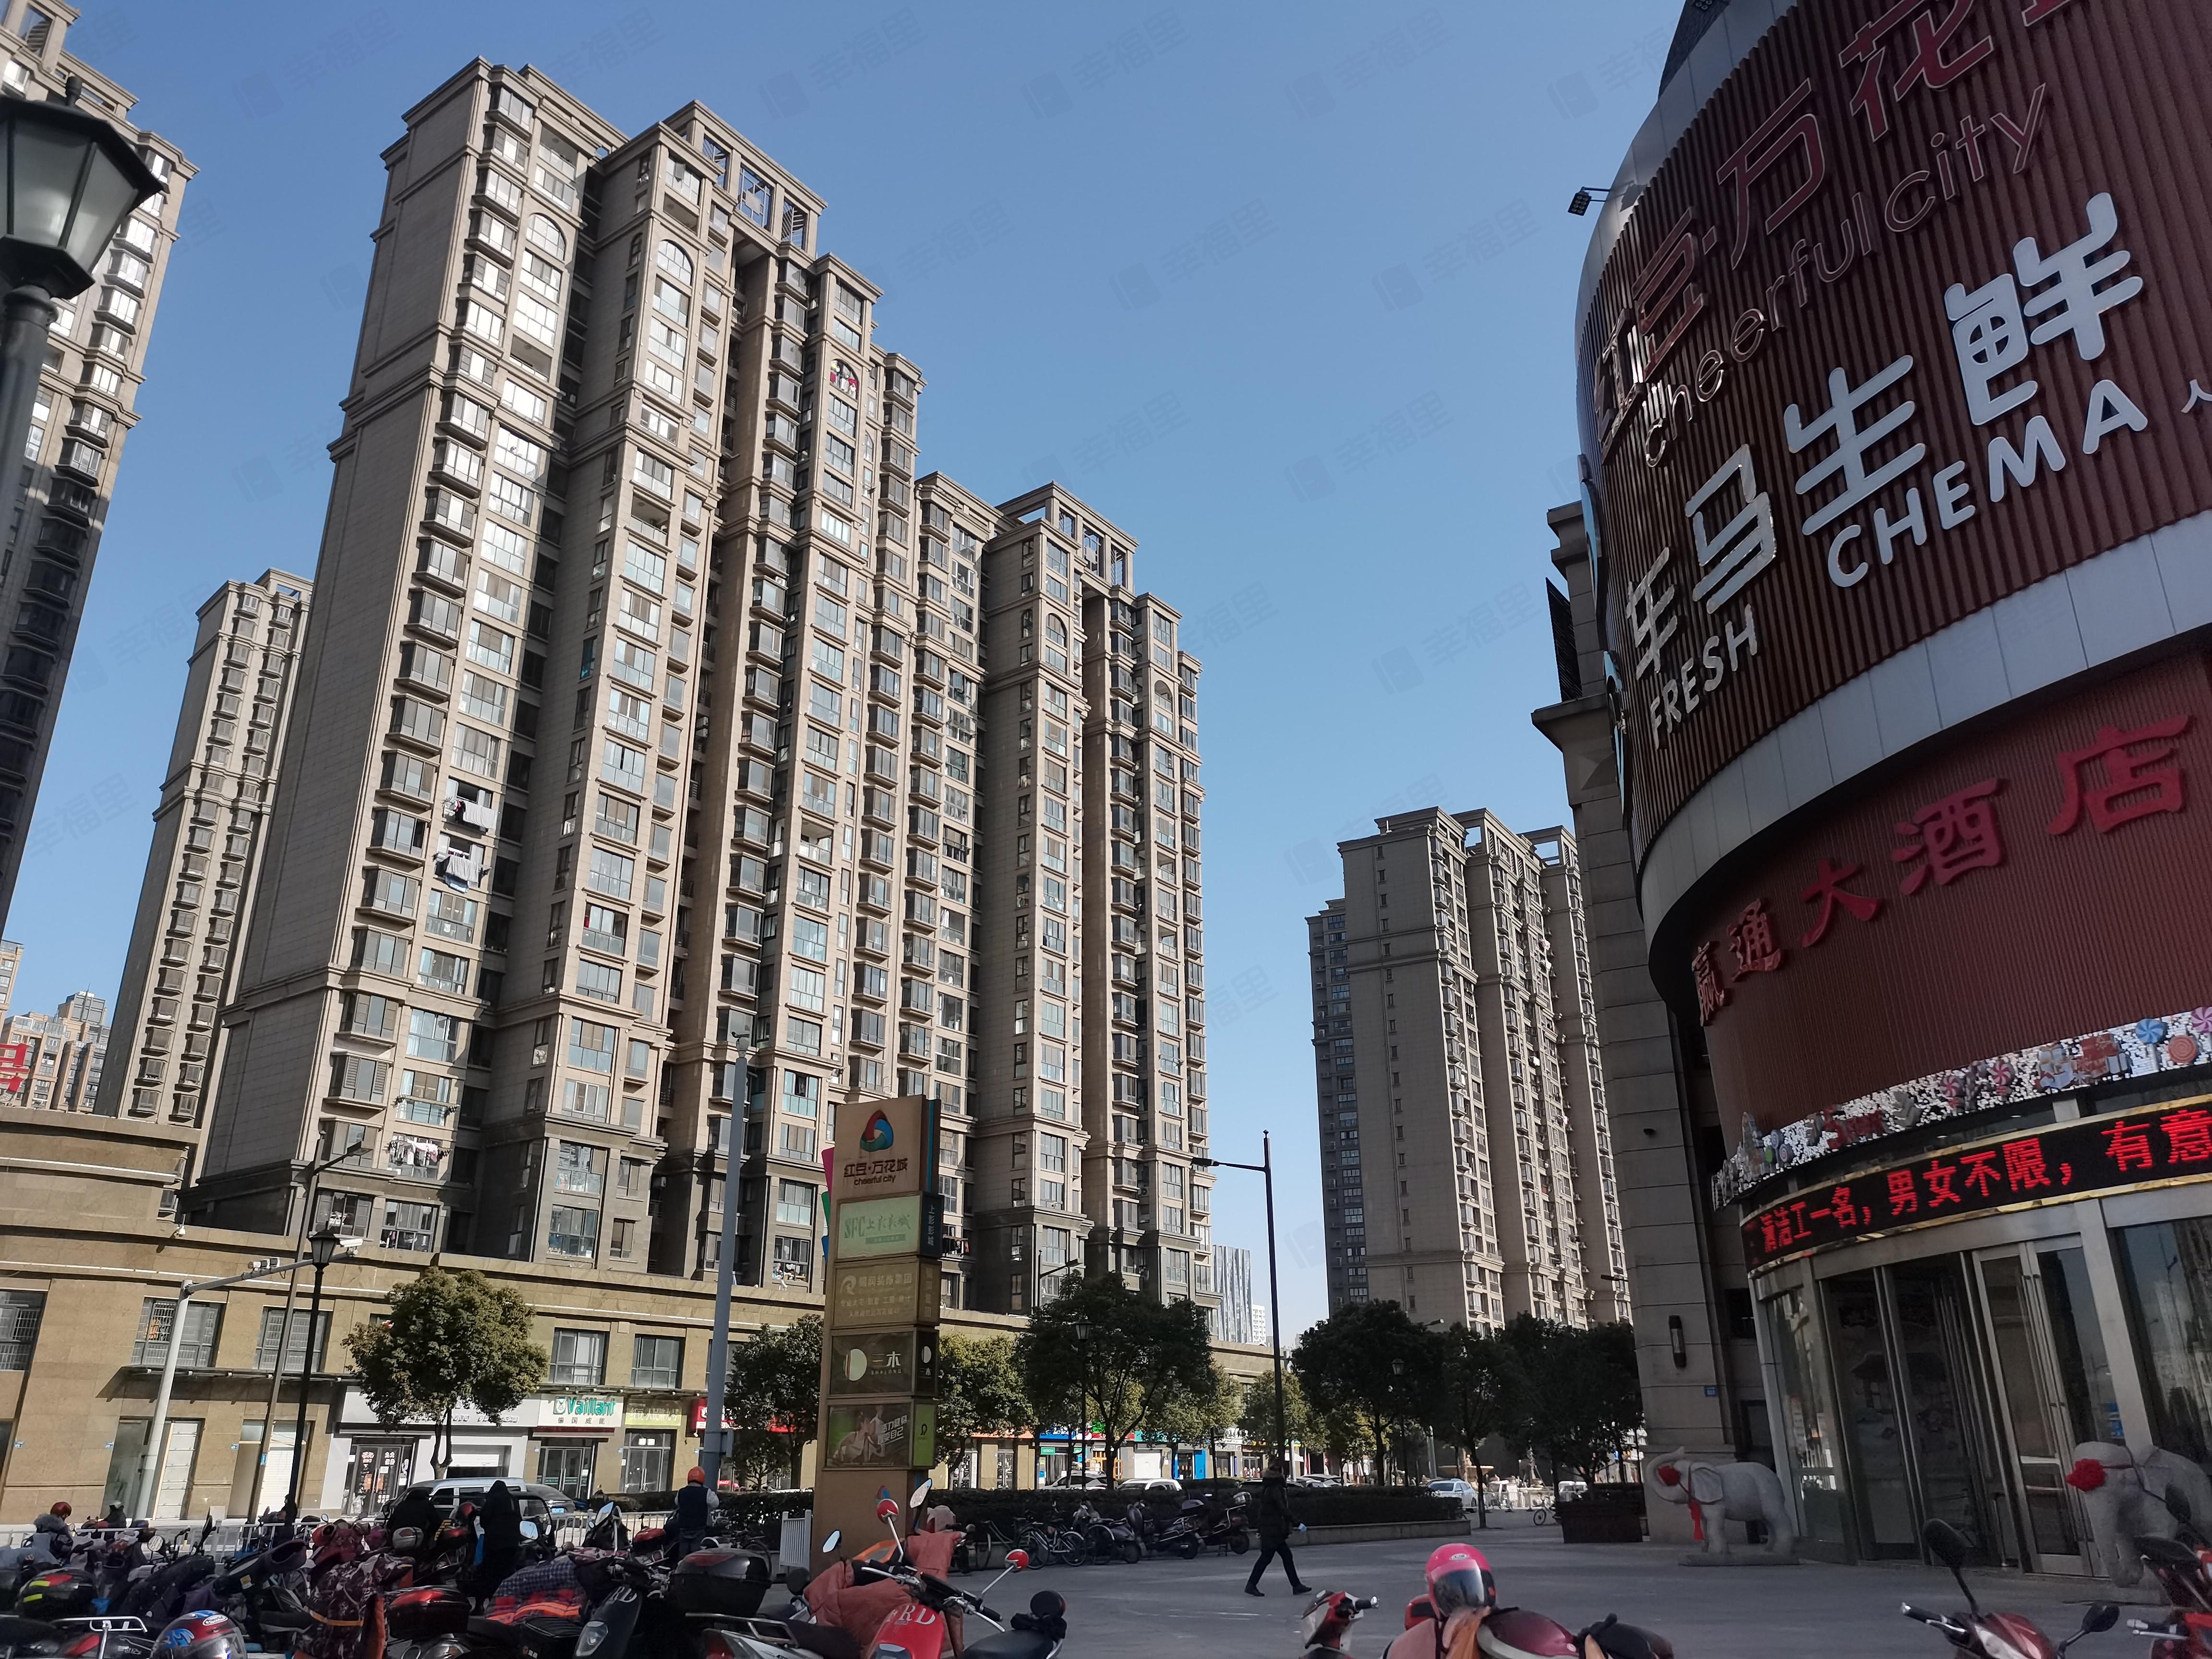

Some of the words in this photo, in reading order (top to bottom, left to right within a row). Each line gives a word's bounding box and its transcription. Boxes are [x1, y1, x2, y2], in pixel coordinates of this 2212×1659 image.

[1650, 604, 1758, 750] FRESH
[1828, 379, 2148, 588] CHEMA
[854, 1176, 882, 1185] cheerful
[883, 1175, 896, 1183] city
[871, 1351, 902, 1368] 三木
[567, 1396, 616, 1416] Vaillant
